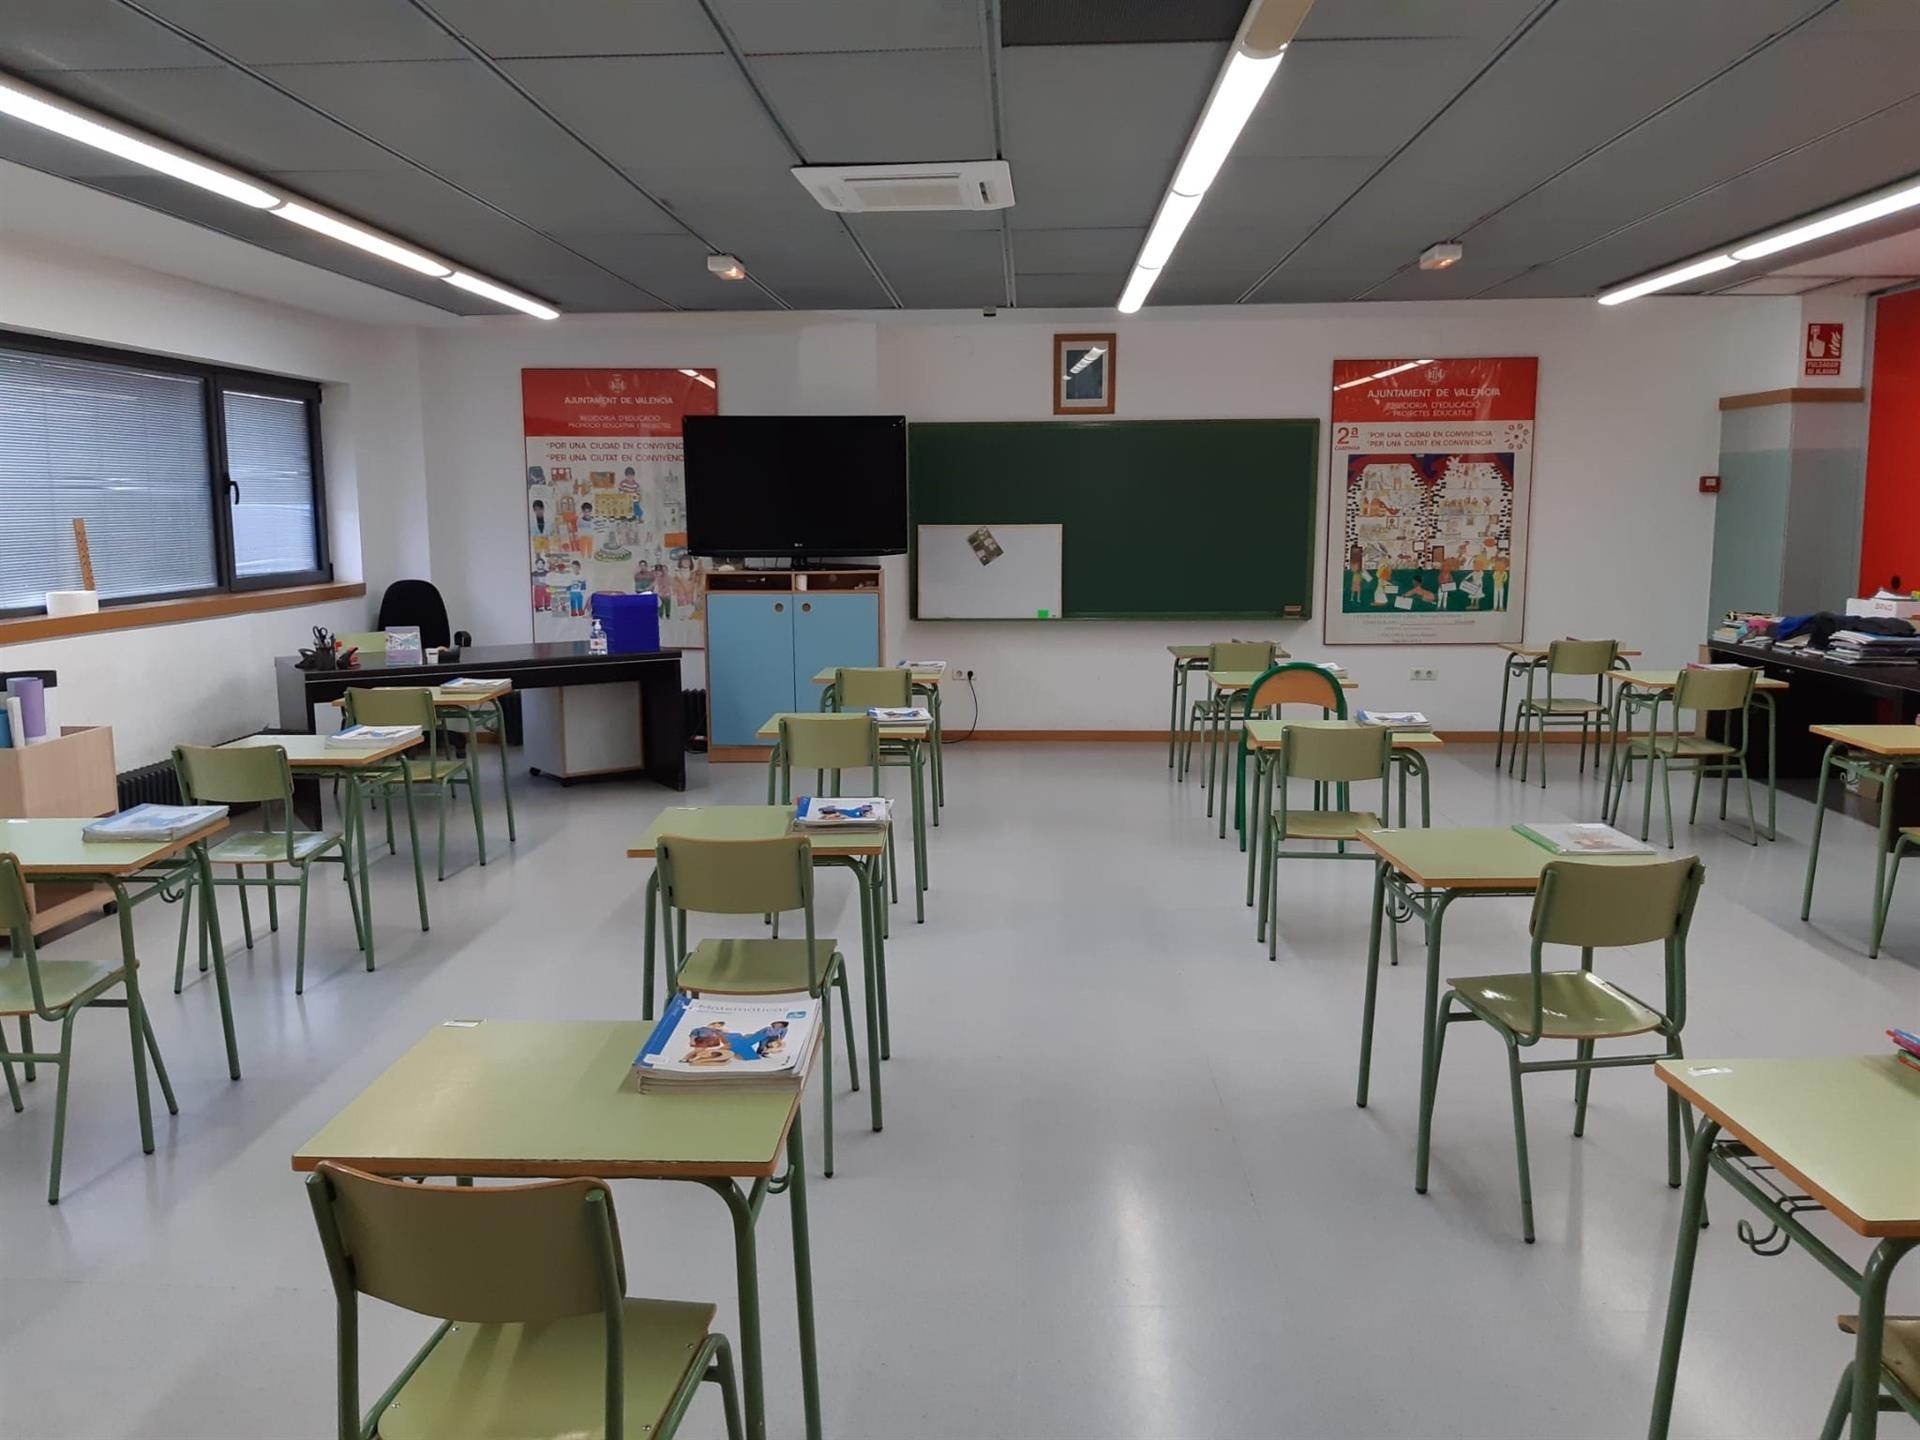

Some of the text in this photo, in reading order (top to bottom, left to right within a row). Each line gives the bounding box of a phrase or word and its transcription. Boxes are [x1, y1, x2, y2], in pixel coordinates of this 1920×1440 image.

[1367, 387, 1501, 398] AJUNTAMENT DE VALENCIA
[564, 396, 673, 405] AJUNTAMENT DE VALENCIA
